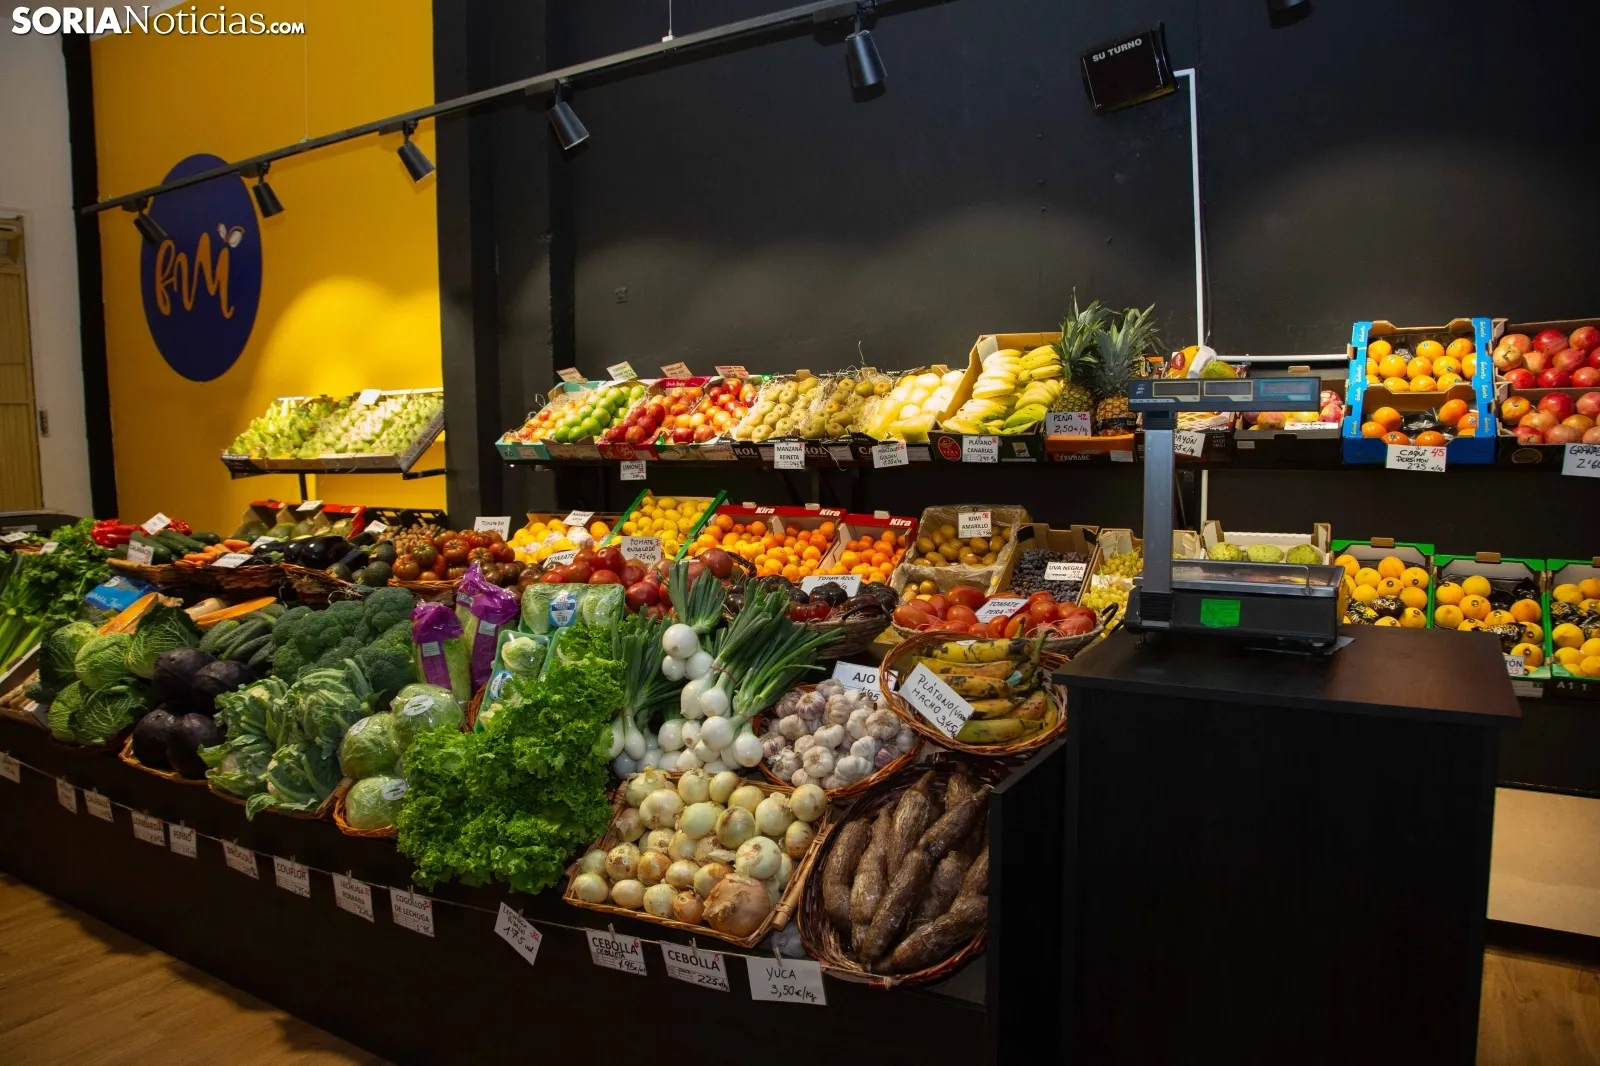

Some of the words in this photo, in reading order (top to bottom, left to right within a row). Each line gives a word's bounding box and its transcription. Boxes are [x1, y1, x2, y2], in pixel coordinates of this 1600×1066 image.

[1092, 50, 1106, 63] SU
[1107, 38, 1143, 58] TURNO
[1053, 411, 1073, 422] PIÑA
[1174, 434, 1198, 445] PAYÓN
[1399, 449, 1428, 457] CAQUI
[1431, 448, 1445, 457] 45
[755, 506, 776, 515] Kira
[819, 508, 841, 517] Kira
[889, 518, 912, 527] Kira
[630, 538, 654, 546] TOMATE
[852, 672, 876, 684] AJO
[916, 673, 954, 711] PLÁTANO
[911, 688, 941, 715] MACHO
[276, 863, 307, 881] COLIFLOR
[340, 881, 364, 894] LECHUGA
[396, 894, 427, 911] COGOLLOS
[394, 904, 403, 913] DE
[403, 906, 430, 924] LECHUGA
[592, 937, 638, 956] CEBOLLA
[633, 938, 640, 949] 6
[668, 950, 720, 972] CEBOLLA
[766, 967, 797, 982] YUCA
